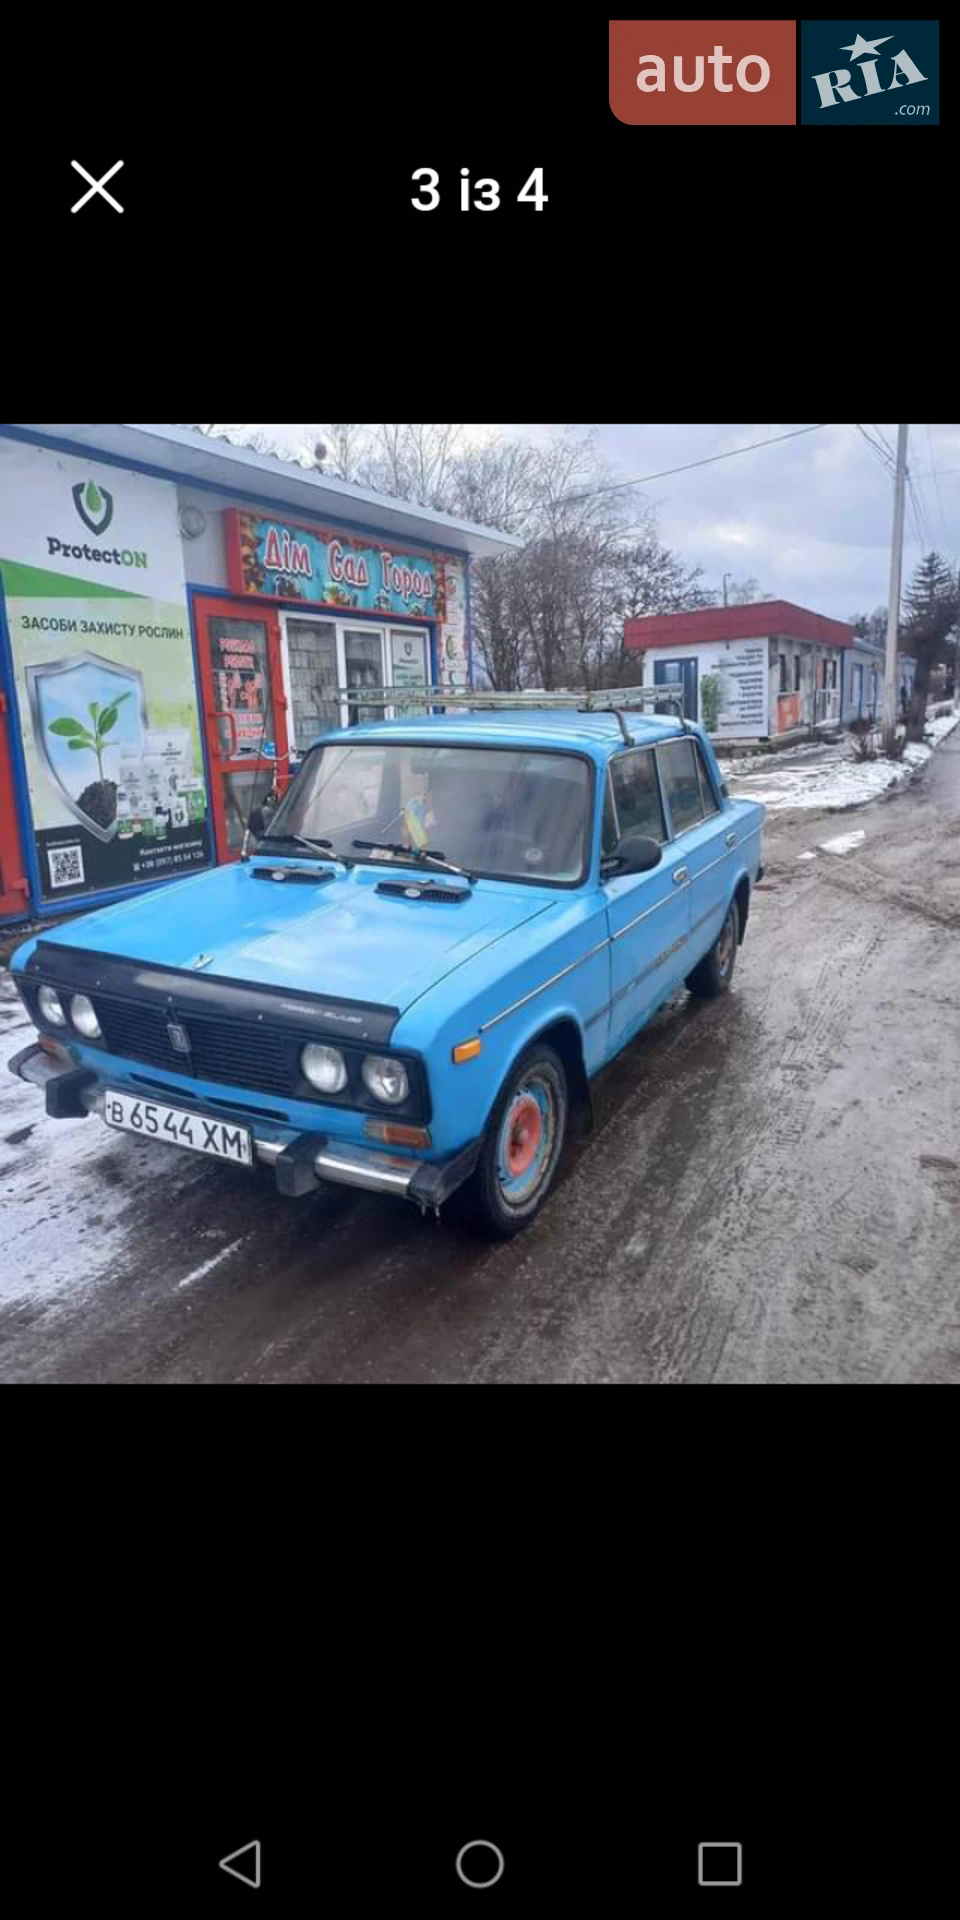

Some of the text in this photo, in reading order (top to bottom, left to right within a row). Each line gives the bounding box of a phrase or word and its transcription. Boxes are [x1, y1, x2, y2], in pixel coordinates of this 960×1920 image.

[46, 536, 148, 568] ProtectON
[263, 526, 433, 604] Дім Сад Город
[21, 615, 184, 640] ЗАСОБИ ЗАХИСТУ РОСЛИН
